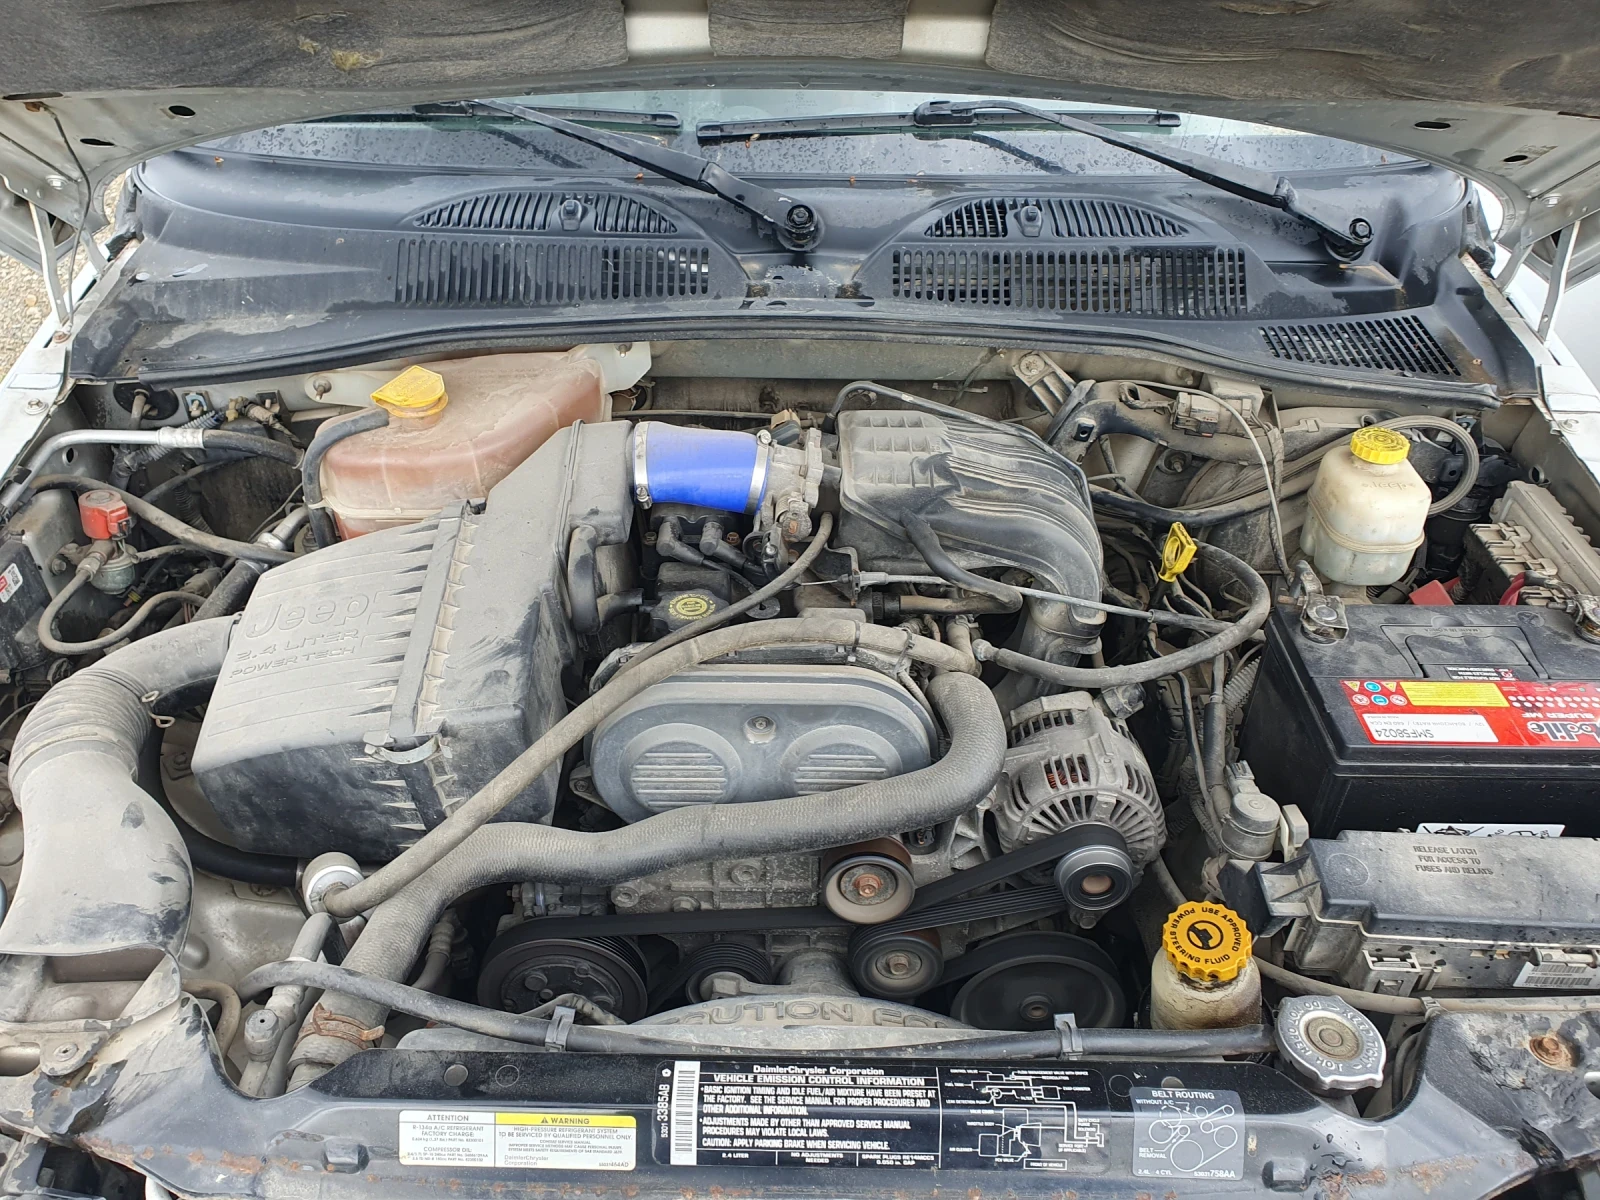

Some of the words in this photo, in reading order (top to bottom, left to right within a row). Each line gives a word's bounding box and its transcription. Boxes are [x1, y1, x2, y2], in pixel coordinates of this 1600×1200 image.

[245, 592, 370, 638] Jeep
[234, 643, 277, 663] 2.4
[283, 628, 359, 651] LITER
[228, 655, 298, 679] POWER
[302, 645, 355, 661] TECH
[1375, 728, 1434, 738] SMF58024
[1412, 846, 1450, 854] RELEASE
[1450, 847, 1478, 856] LATCH
[1437, 856, 1468, 864] ACCESS
[1415, 864, 1442, 872] FUSES
[1444, 866, 1460, 874] AND
[1462, 867, 1494, 875] RELAYS
[1170, 907, 1196, 929] POWER
[1202, 906, 1220, 916] USE
[1221, 914, 1242, 952] APPROVED
[1170, 930, 1201, 963] STEERING
[1204, 954, 1230, 964] FLUID
[1304, 1000, 1322, 1010] DO
[1290, 1006, 1304, 1025] NOT
[1288, 1027, 1313, 1058] OPEN
[752, 1065, 827, 1076] DaimlerChrysler
[830, 1066, 884, 1076] Corporation
[714, 1074, 754, 1082] VEHICLE
[757, 1074, 808, 1084] EMISSION
[808, 1076, 854, 1084] CONTROL
[856, 1076, 925, 1086] INFORMATION
[704, 1086, 722, 1094] BASIC
[724, 1086, 751, 1094] IGNITION
[753, 1086, 775, 1095] TIMING
[776, 1087, 790, 1095] AND
[792, 1087, 806, 1095] IDLE
[806, 1088, 836, 1096] FUEL/AIR
[836, 1088, 864, 1096] MIXTURE
[866, 1088, 883, 1097] HAVE
[884, 1089, 901, 1097] BEEN
[902, 1090, 926, 1098] PRESET
[928, 1090, 936, 1098] AT
[1152, 1090, 1173, 1098] BELT
[1176, 1091, 1214, 1099] ROUTING
[704, 1094, 716, 1102] THE
[716, 1095, 746, 1104] FACTORY.
[750, 1096, 762, 1104] SEE
[764, 1096, 776, 1104] THE
[778, 1096, 803, 1104] SERVICE
[805, 1096, 832, 1105] MANUAL
[834, 1097, 846, 1106] FOR
[848, 1098, 872, 1106] PROPER
[874, 1098, 914, 1107] PROCEDURES
[916, 1099, 930, 1107] AND
[703, 1104, 724, 1114] OTHER
[725, 1105, 762, 1114] ADDITIONAL
[763, 1106, 808, 1115] INFORMATION.
[702, 1117, 748, 1126] ADJUSTMENTS
[750, 1118, 768, 1126] MADE
[770, 1118, 779, 1126] BY
[780, 1118, 801, 1127] OTHER
[802, 1119, 820, 1128] THAN
[821, 1119, 854, 1128] APPROVED
[856, 1120, 882, 1128] SERVICE
[884, 1120, 911, 1129] MANUAL
[702, 1126, 744, 1136] PROCEDURES
[746, 1127, 760, 1136] MAY
[762, 1128, 786, 1136] VIOLATE
[788, 1128, 808, 1136] LOCAL
[809, 1128, 829, 1137] LAWS.
[702, 1138, 732, 1147] CAUTION:
[733, 1139, 753, 1147] APPLY
[755, 1139, 782, 1148] PARKING
[784, 1140, 805, 1148] BRAKE
[806, 1140, 826, 1148] WHEN
[828, 1140, 861, 1149] SERVICING
[862, 1141, 890, 1150] VEHICLE.
